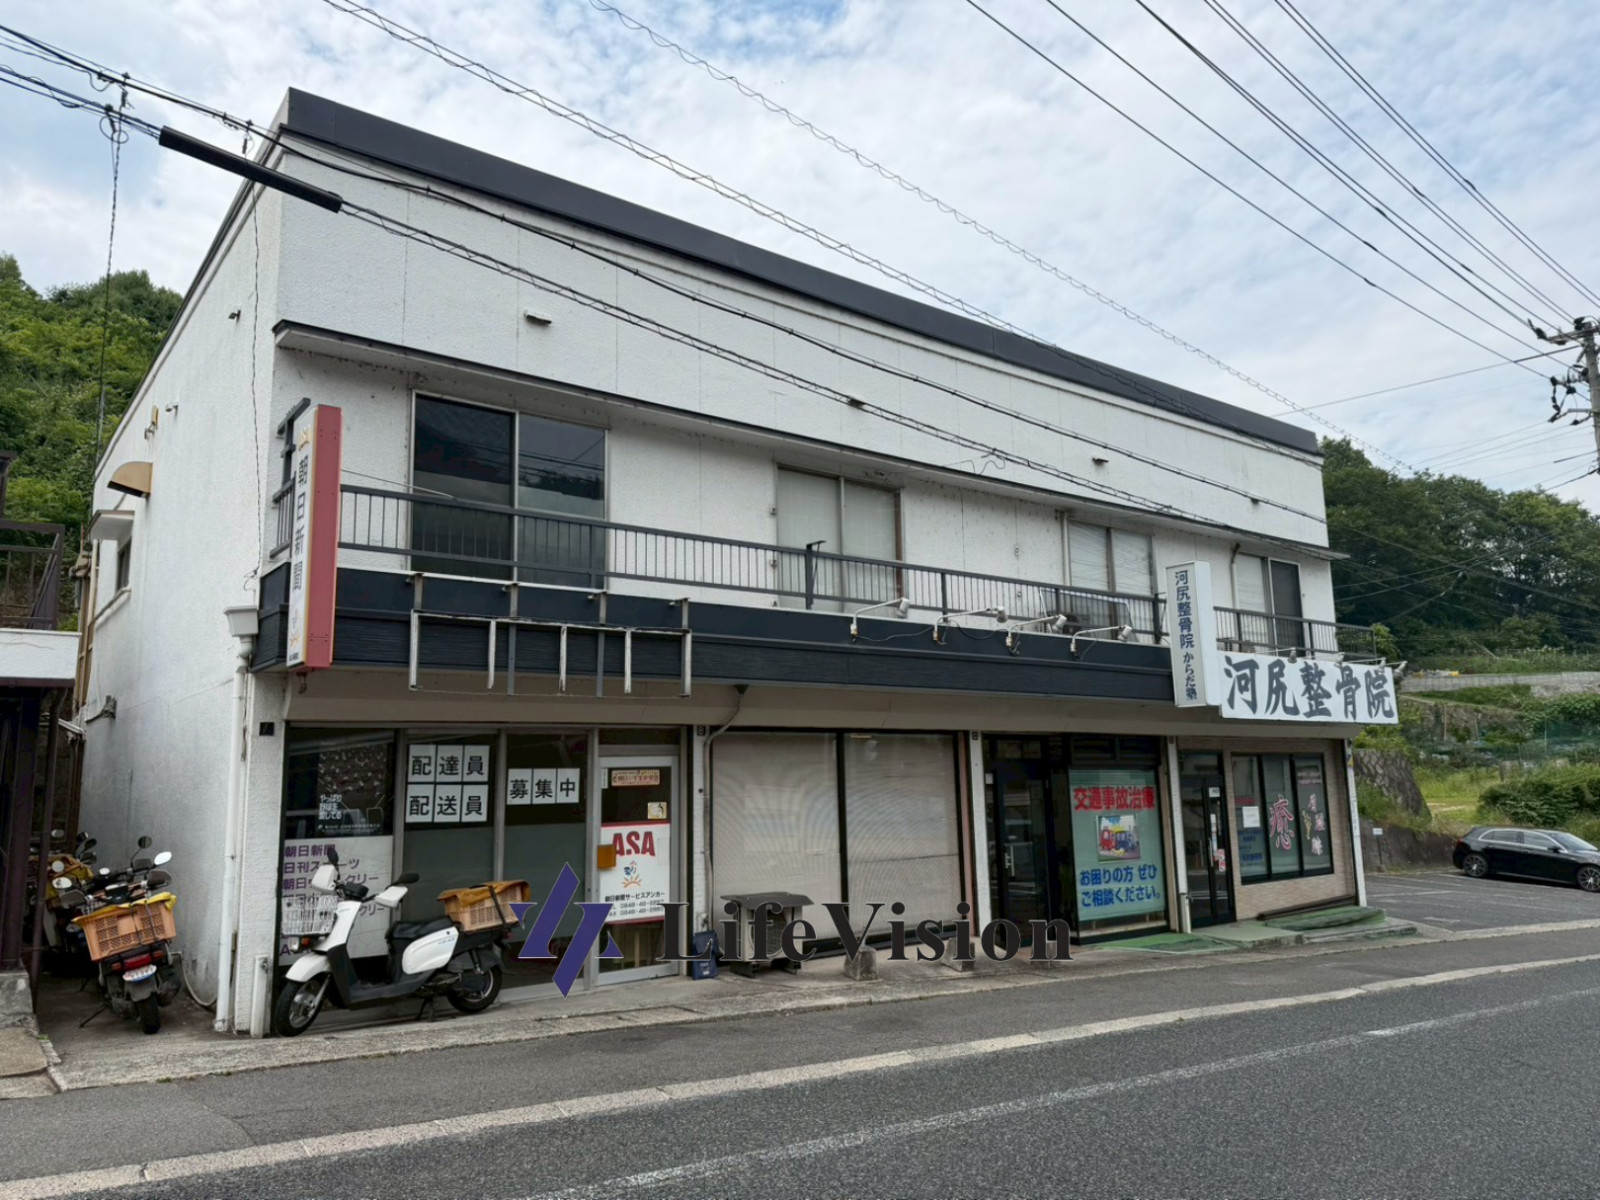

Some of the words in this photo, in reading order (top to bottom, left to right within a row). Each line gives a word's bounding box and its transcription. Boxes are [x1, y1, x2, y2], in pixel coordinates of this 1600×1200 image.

[1175, 570, 1195, 649] 河尻整骨院
[1183, 652, 1197, 699] からだ塾
[1224, 655, 1395, 720] 河尻整骨院
[411, 755, 484, 776] 配達員
[510, 778, 576, 799] 募集中
[1074, 786, 1155, 811] 交通事故治療
[409, 795, 483, 816] 配送員
[613, 831, 656, 857] ASA
[284, 859, 360, 874] 日刊スーツ
[1080, 866, 1133, 886] お困りの方
[1138, 864, 1157, 880] ぜひ
[1082, 885, 1160, 907] ご相談ください。
